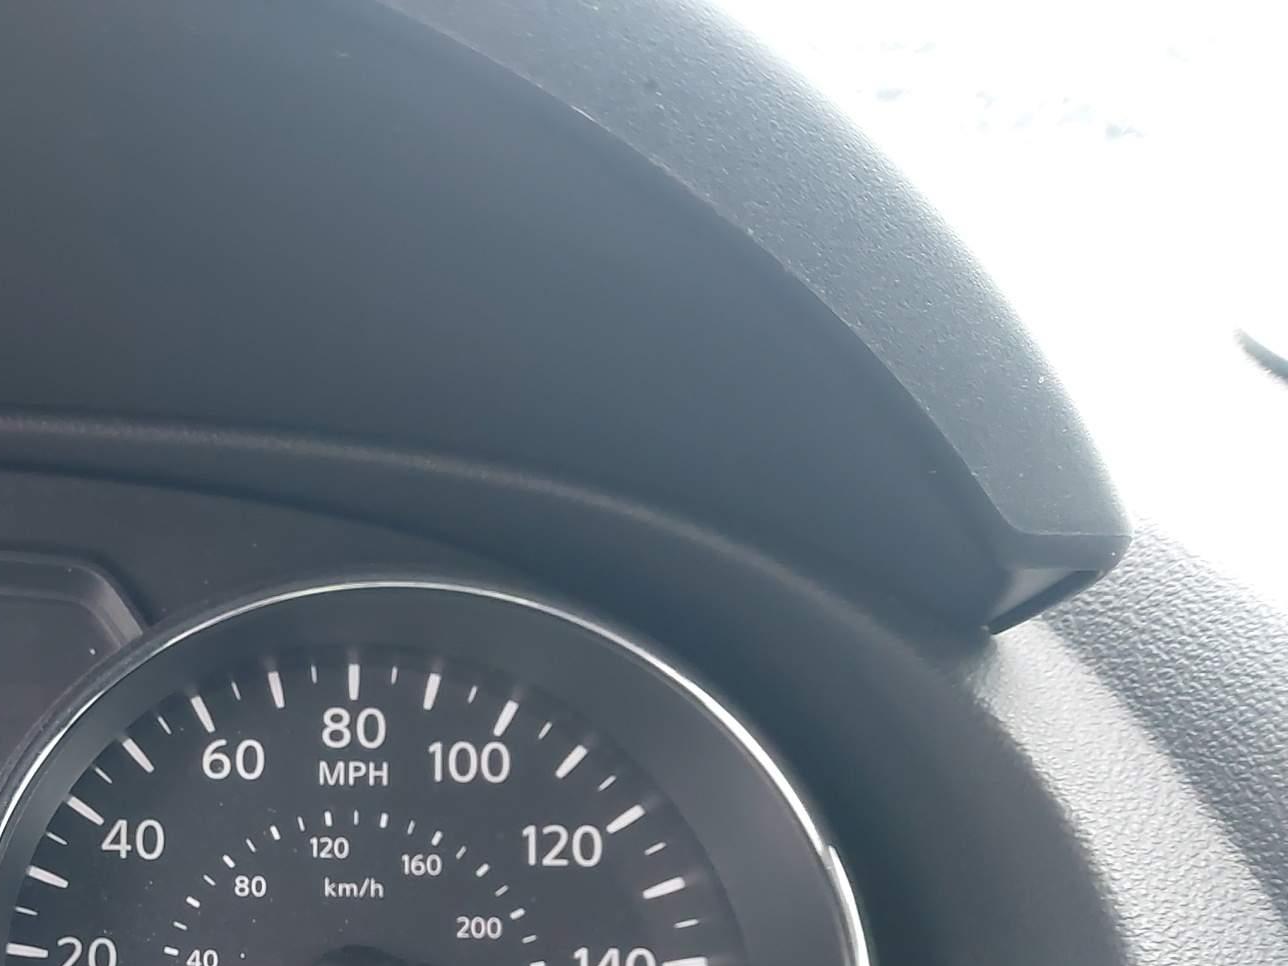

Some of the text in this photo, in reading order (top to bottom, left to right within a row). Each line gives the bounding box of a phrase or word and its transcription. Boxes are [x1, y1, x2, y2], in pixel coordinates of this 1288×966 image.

[322, 708, 385, 748] 80
[203, 740, 264, 780] 60
[319, 760, 388, 786] MPH
[429, 742, 511, 783] 100
[102, 819, 164, 859] 40
[310, 837, 350, 859] 120
[523, 825, 602, 867] 120
[402, 854, 442, 876] 160
[234, 875, 266, 897] 80
[324, 877, 384, 898] km/h
[457, 916, 502, 939] 200
